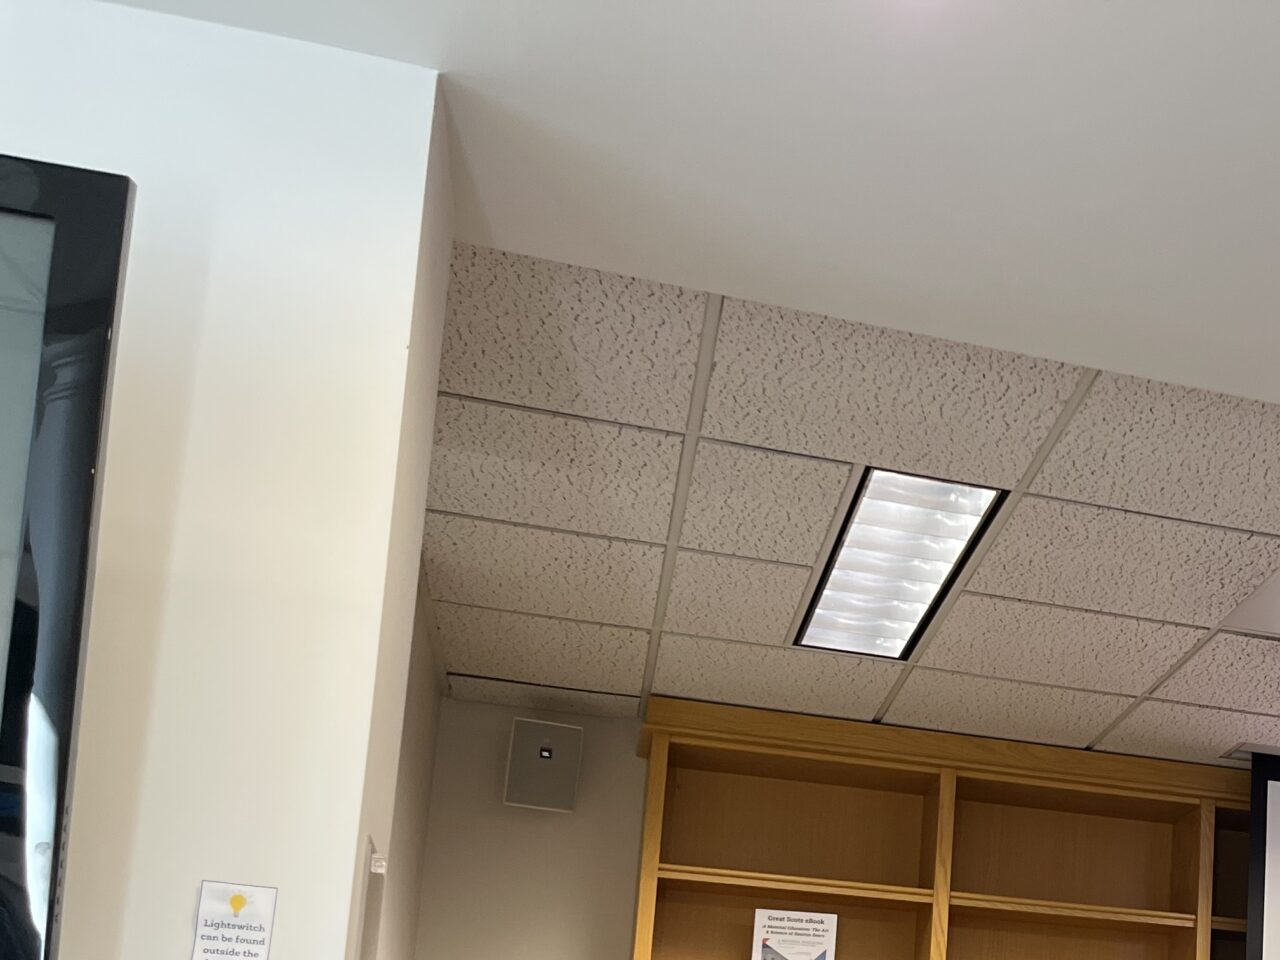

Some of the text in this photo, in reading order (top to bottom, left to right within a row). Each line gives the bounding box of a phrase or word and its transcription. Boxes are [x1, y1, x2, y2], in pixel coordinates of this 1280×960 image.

[768, 915, 785, 923] Great
[204, 919, 265, 933] Lightswitch
[200, 934, 265, 946] can be found
[203, 947, 259, 958] outside the
